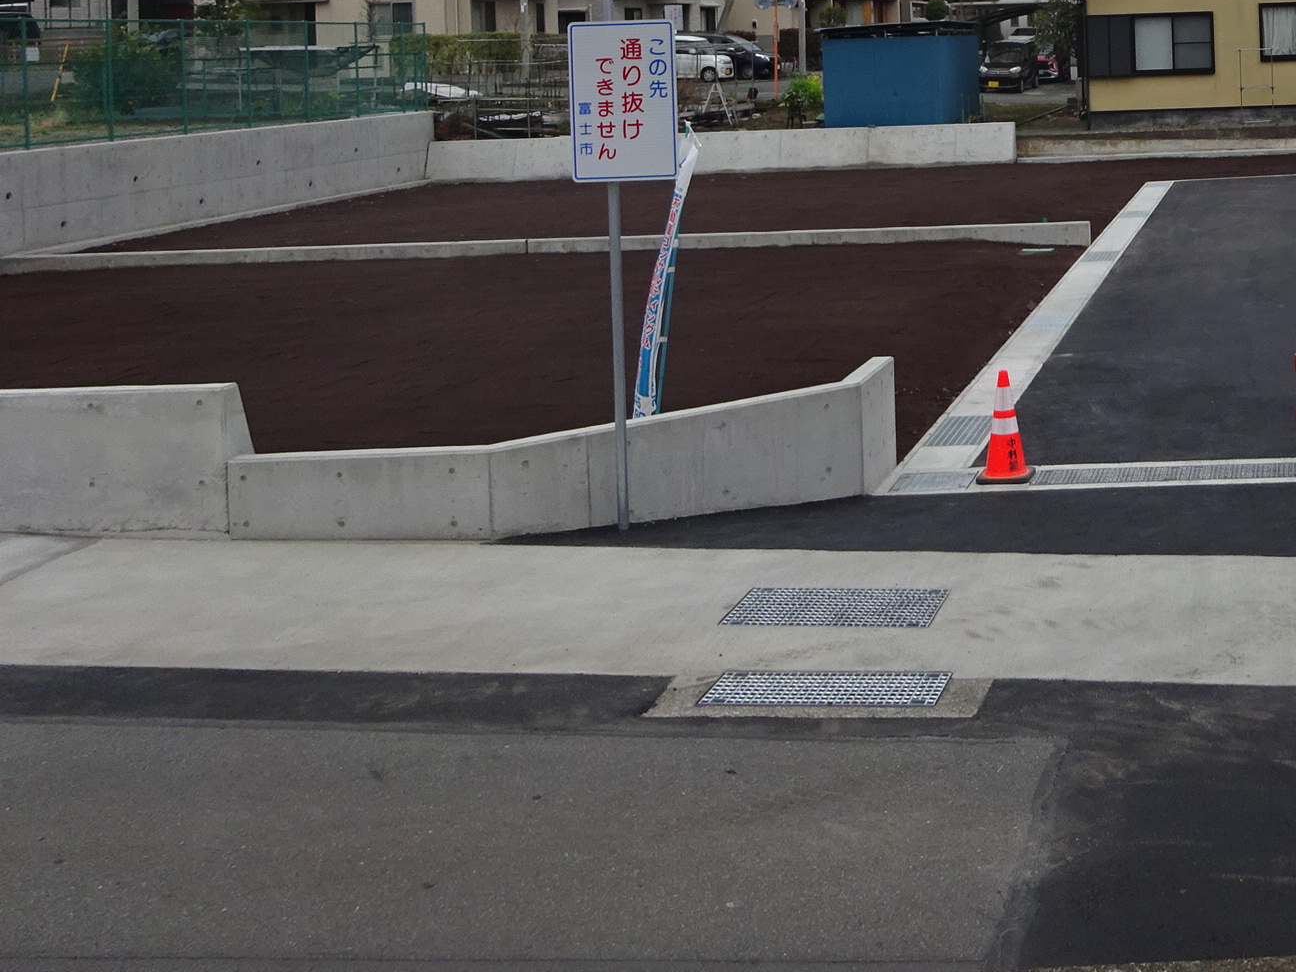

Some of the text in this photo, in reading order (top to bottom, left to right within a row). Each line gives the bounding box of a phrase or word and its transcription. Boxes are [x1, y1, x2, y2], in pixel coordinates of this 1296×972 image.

[595, 57, 617, 160] できません
[620, 38, 645, 140] 通り抜け
[649, 39, 668, 98] この先
[578, 102, 593, 156] 富士市
